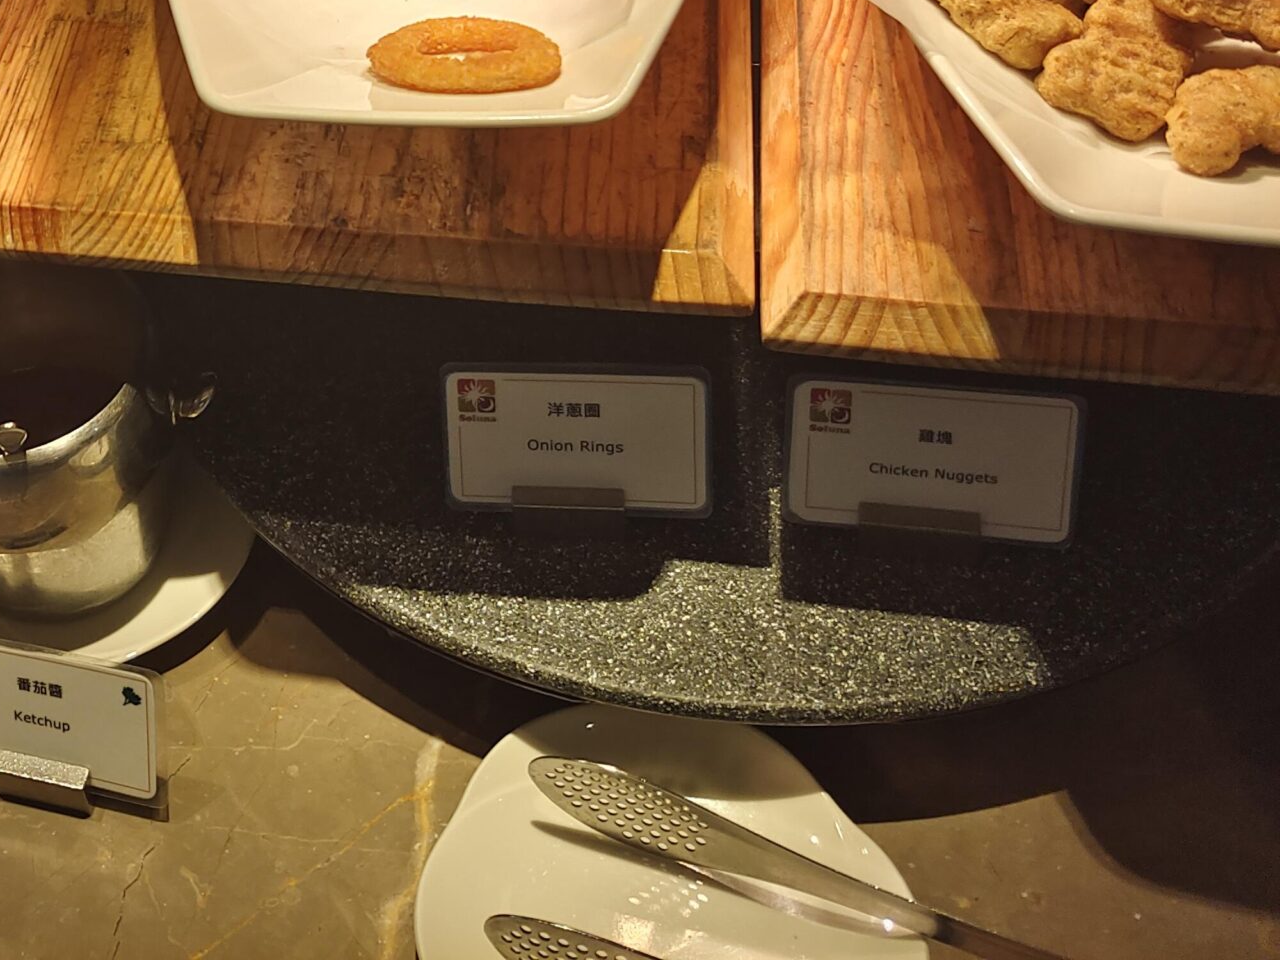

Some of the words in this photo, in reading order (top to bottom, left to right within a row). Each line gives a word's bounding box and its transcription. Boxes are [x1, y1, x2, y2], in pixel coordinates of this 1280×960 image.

[527, 438, 573, 452] Onion
[580, 440, 624, 456] Rings
[869, 462, 929, 478] Chicken
[934, 468, 998, 485] Nuggets
[16, 676, 63, 699] 番茄醬
[14, 709, 71, 733] Ketchup
